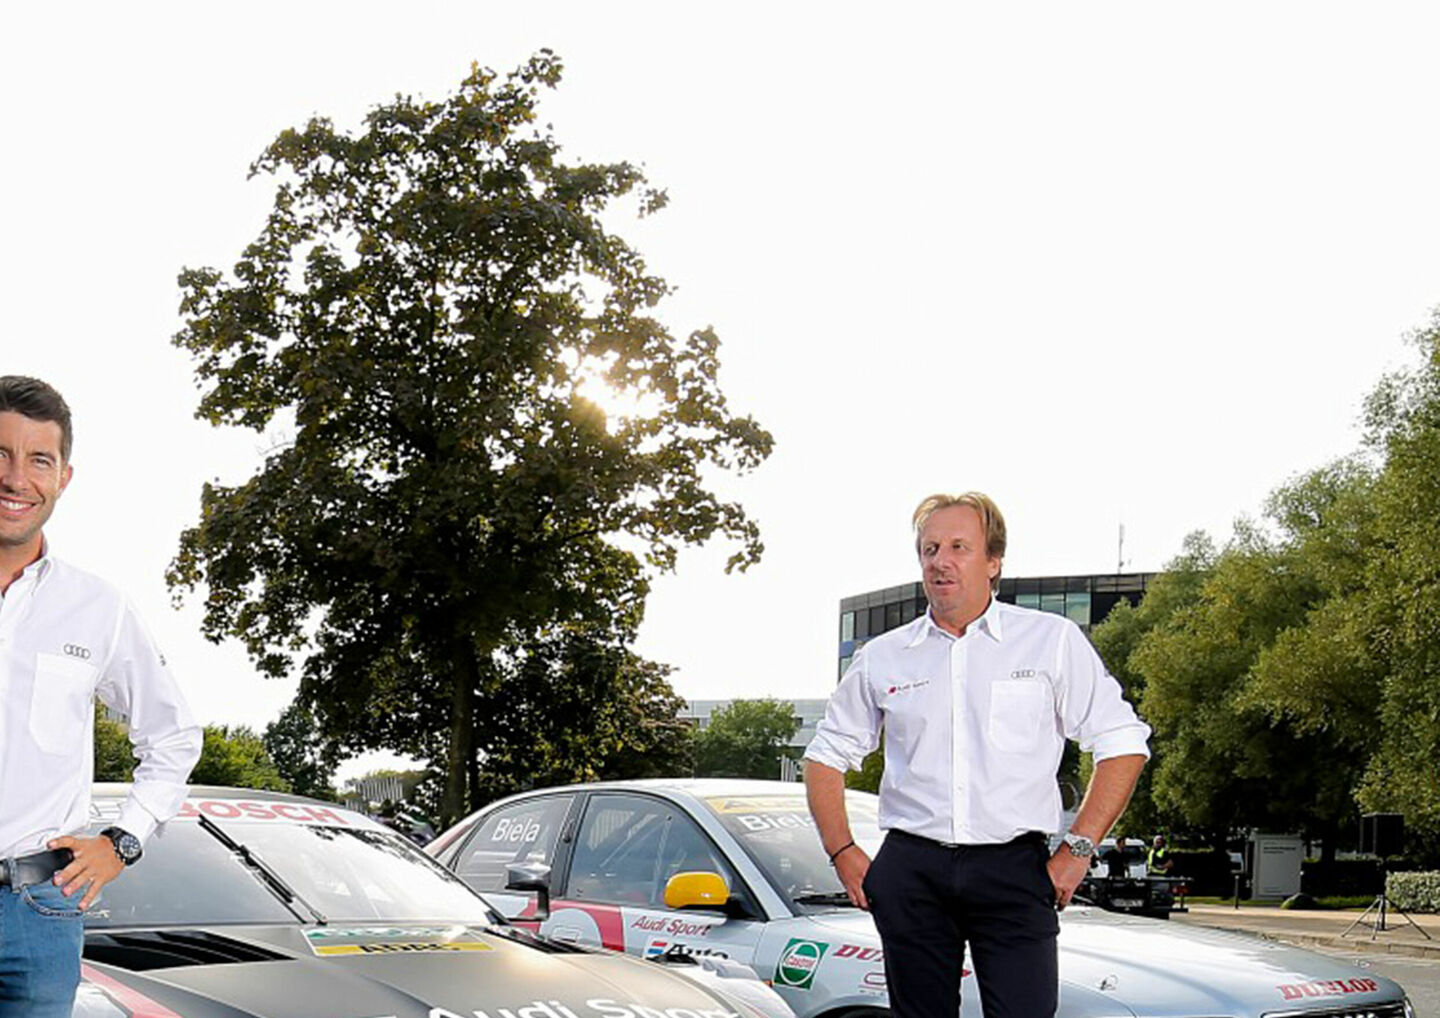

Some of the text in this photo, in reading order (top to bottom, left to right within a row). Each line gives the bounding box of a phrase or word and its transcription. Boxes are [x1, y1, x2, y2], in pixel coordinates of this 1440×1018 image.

[177, 800, 349, 826] BOSCH
[491, 818, 540, 843] Biela
[631, 915, 712, 936] Audi Sport
[783, 954, 816, 968] Castrol
[1276, 976, 1379, 1000] DUNLOP
